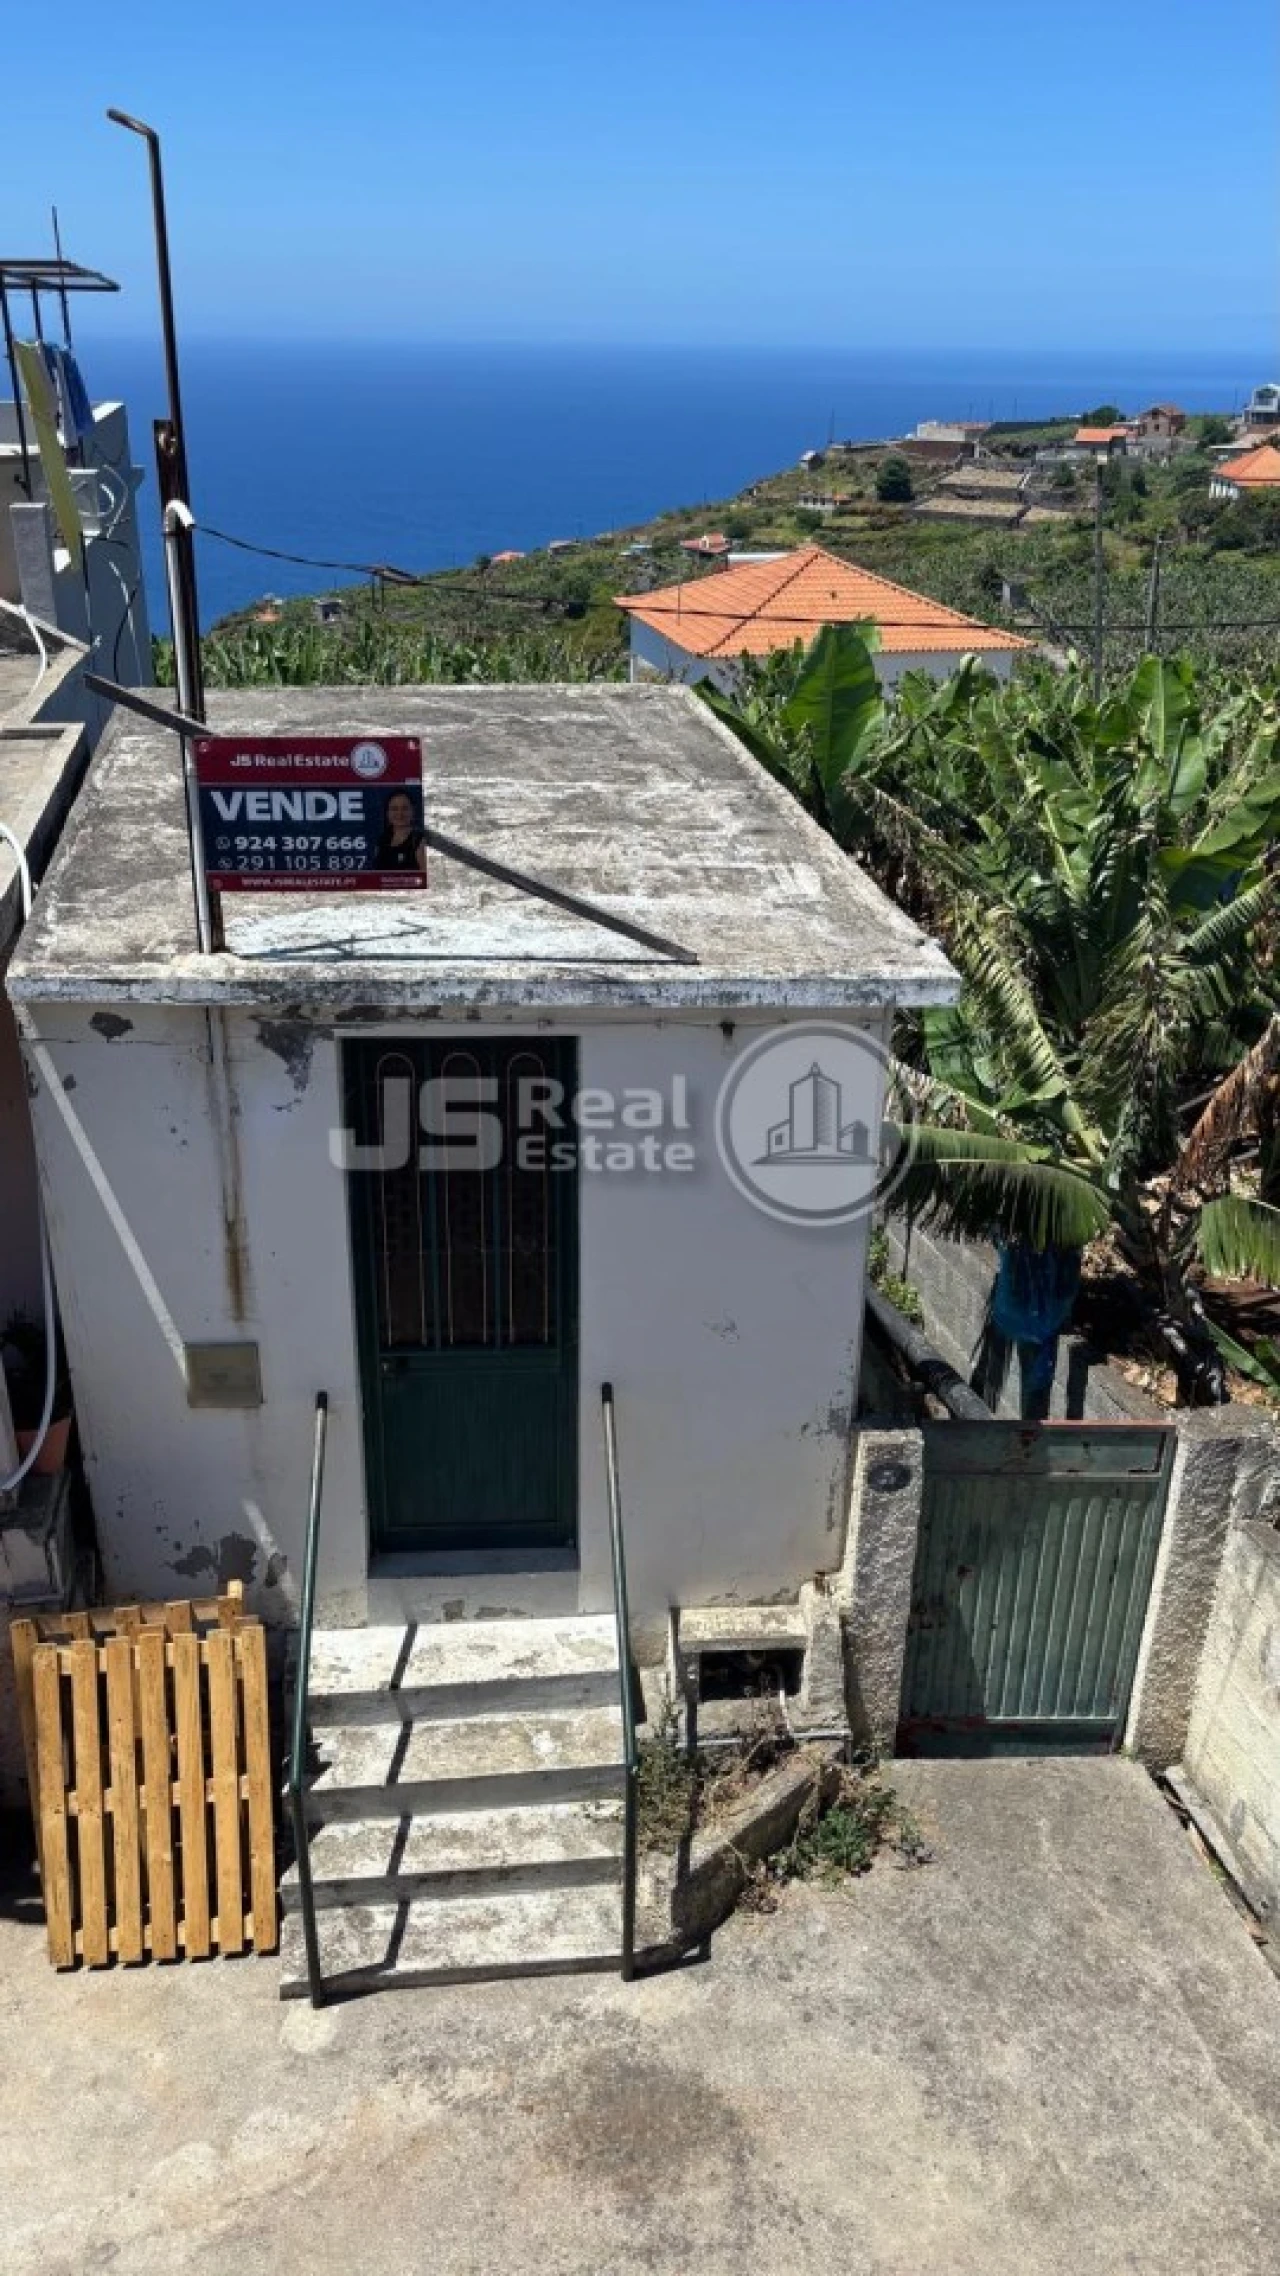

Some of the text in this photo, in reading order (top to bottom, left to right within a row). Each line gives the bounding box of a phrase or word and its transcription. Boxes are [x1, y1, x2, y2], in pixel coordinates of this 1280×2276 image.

[210, 791, 365, 820] VENDE
[234, 836, 367, 850] 924 307 666
[236, 856, 368, 870] 291 105 897
